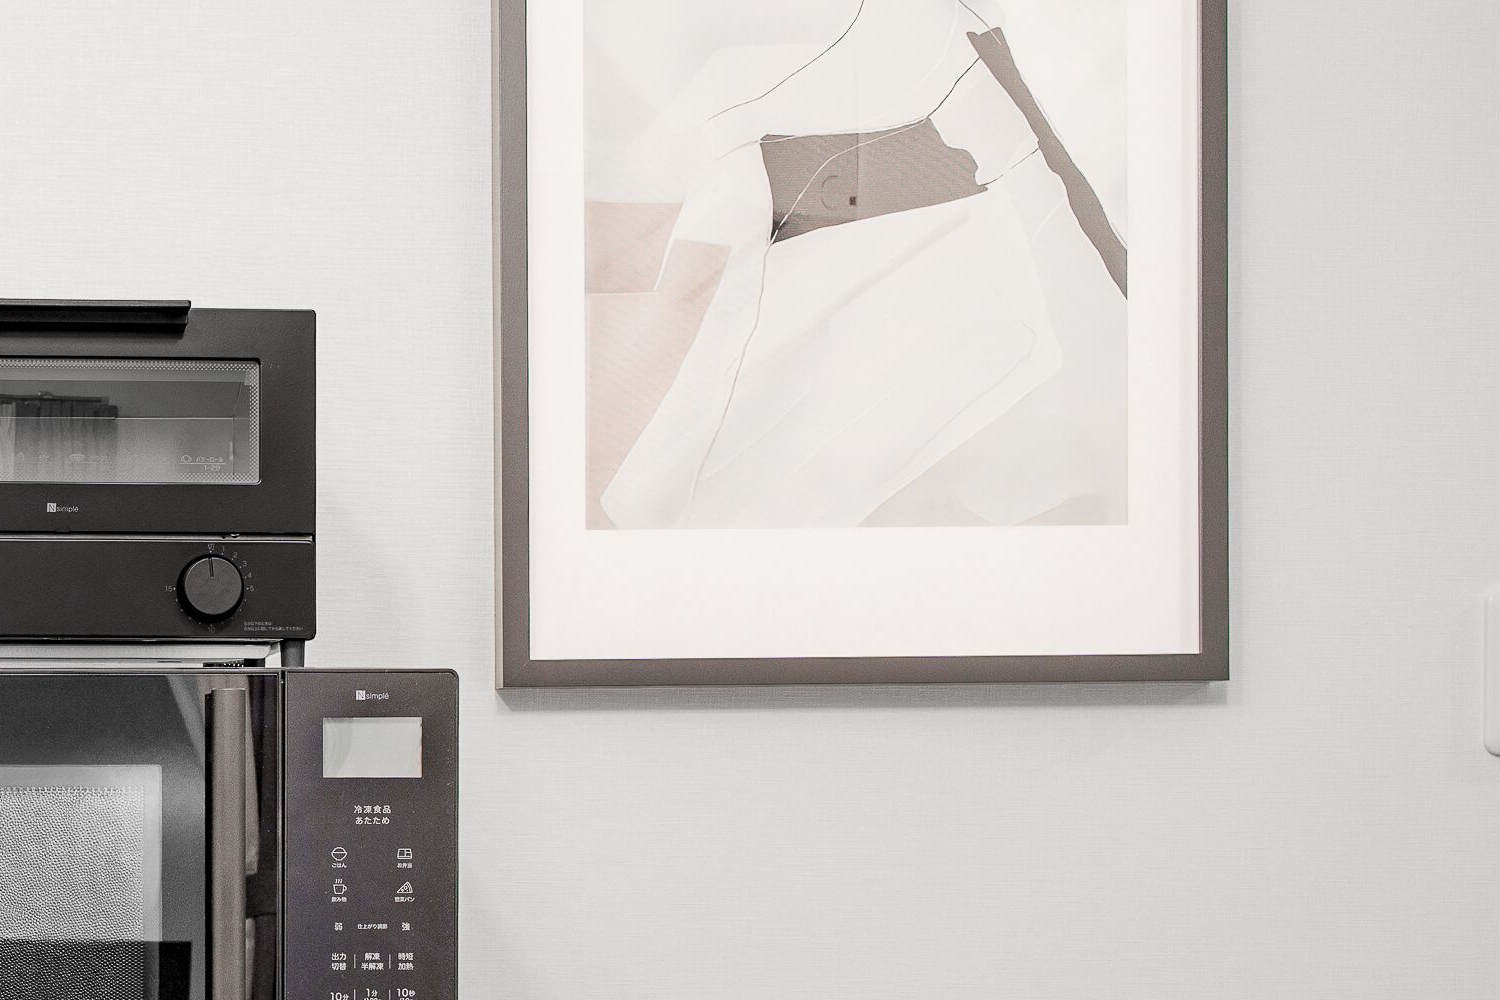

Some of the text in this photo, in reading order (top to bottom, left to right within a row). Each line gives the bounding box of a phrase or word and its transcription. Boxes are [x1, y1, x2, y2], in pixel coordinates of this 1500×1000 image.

[354, 804, 391, 814] 冷凍食品
[355, 816, 390, 825] あたため
[401, 922, 411, 931] 強
[331, 952, 347, 961] 出力
[364, 952, 381, 961] 解凍
[331, 962, 347, 971] 切替
[361, 962, 384, 971] 半解凍
[397, 962, 414, 971] 加熱
[330, 992, 349, 1000] 10分
[366, 988, 378, 997] 1分
[396, 988, 415, 997] 10秒
